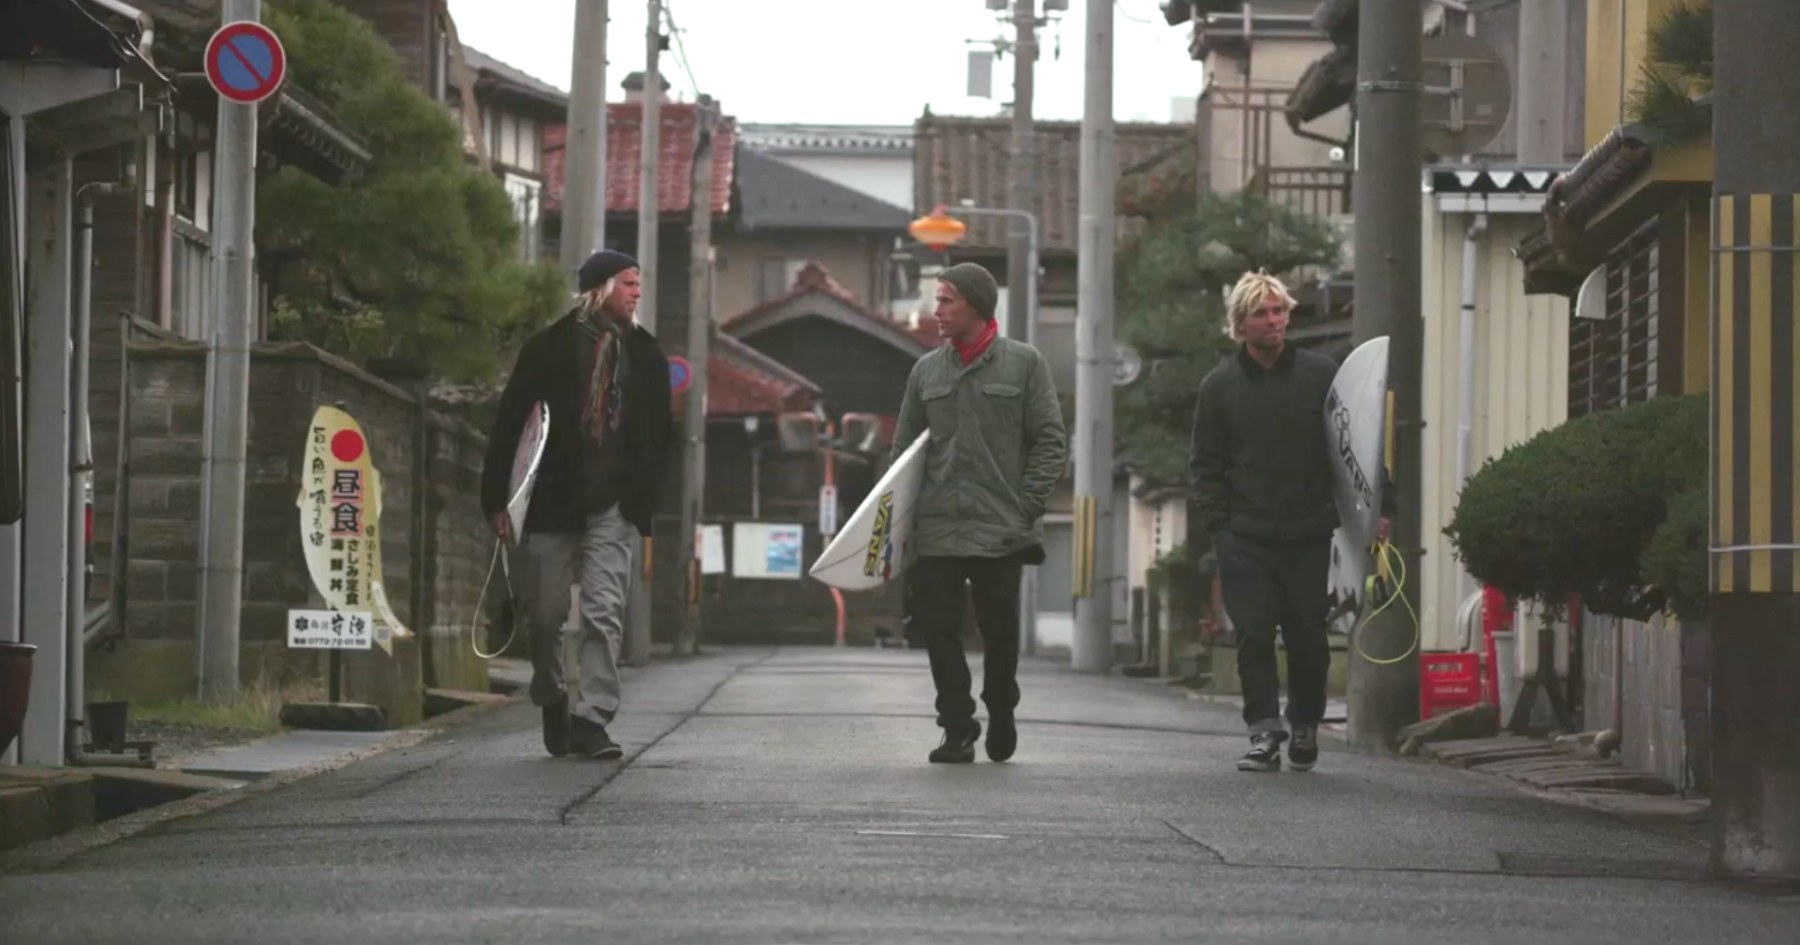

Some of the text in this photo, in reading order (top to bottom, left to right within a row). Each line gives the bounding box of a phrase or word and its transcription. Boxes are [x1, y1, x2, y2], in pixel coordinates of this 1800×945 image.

[331, 469, 360, 533] 昼食
[863, 490, 894, 577] VANS
[330, 538, 345, 592] 海鮮丼
[346, 538, 360, 606] さしみ定食
